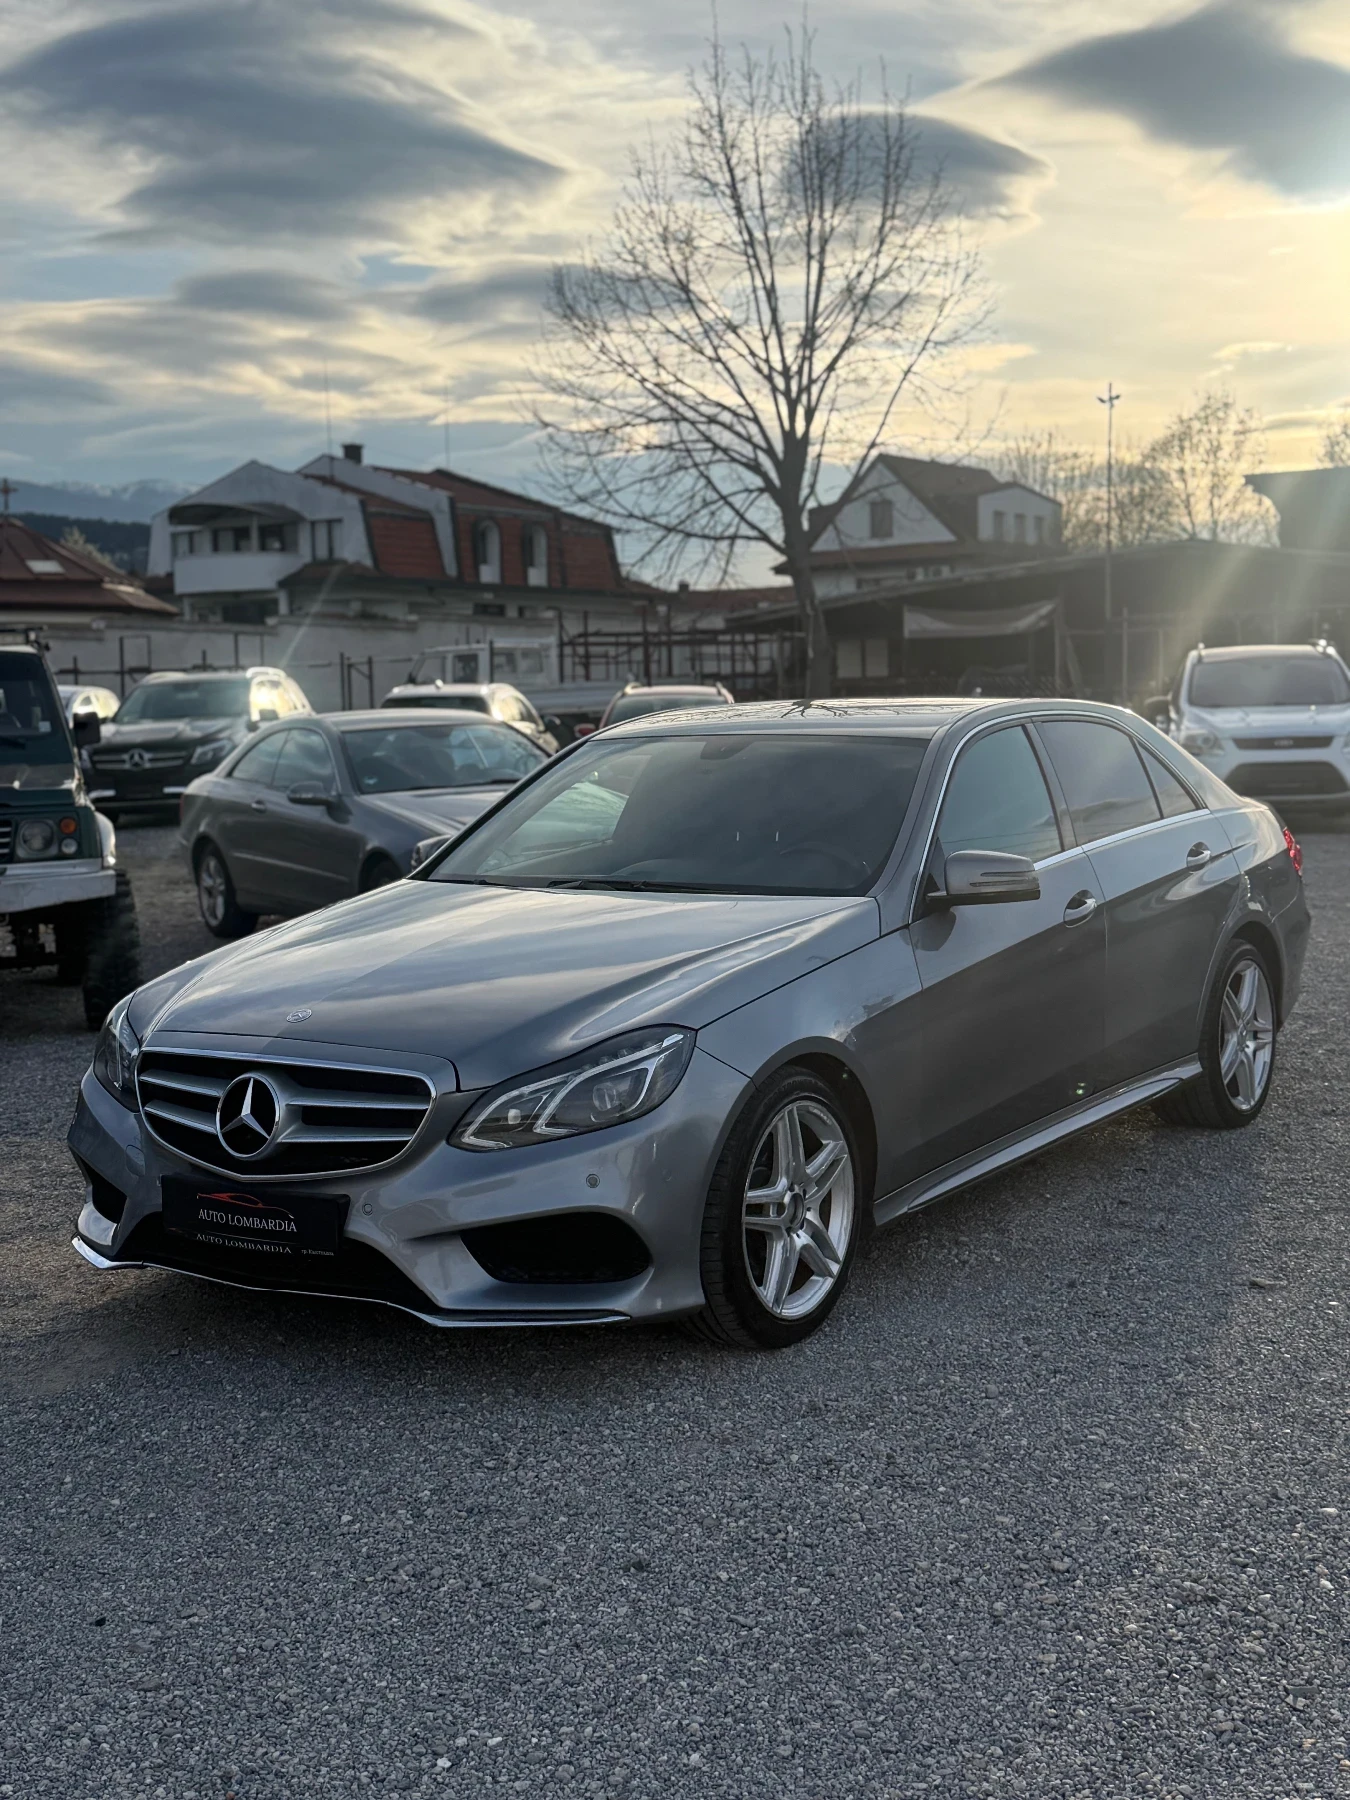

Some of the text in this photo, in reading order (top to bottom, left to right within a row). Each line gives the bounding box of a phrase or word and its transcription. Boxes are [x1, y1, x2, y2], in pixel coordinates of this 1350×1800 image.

[199, 1208, 297, 1232] AUTO LOMBARDIA
[196, 1233, 292, 1254] AUTO LOMBARDIA
